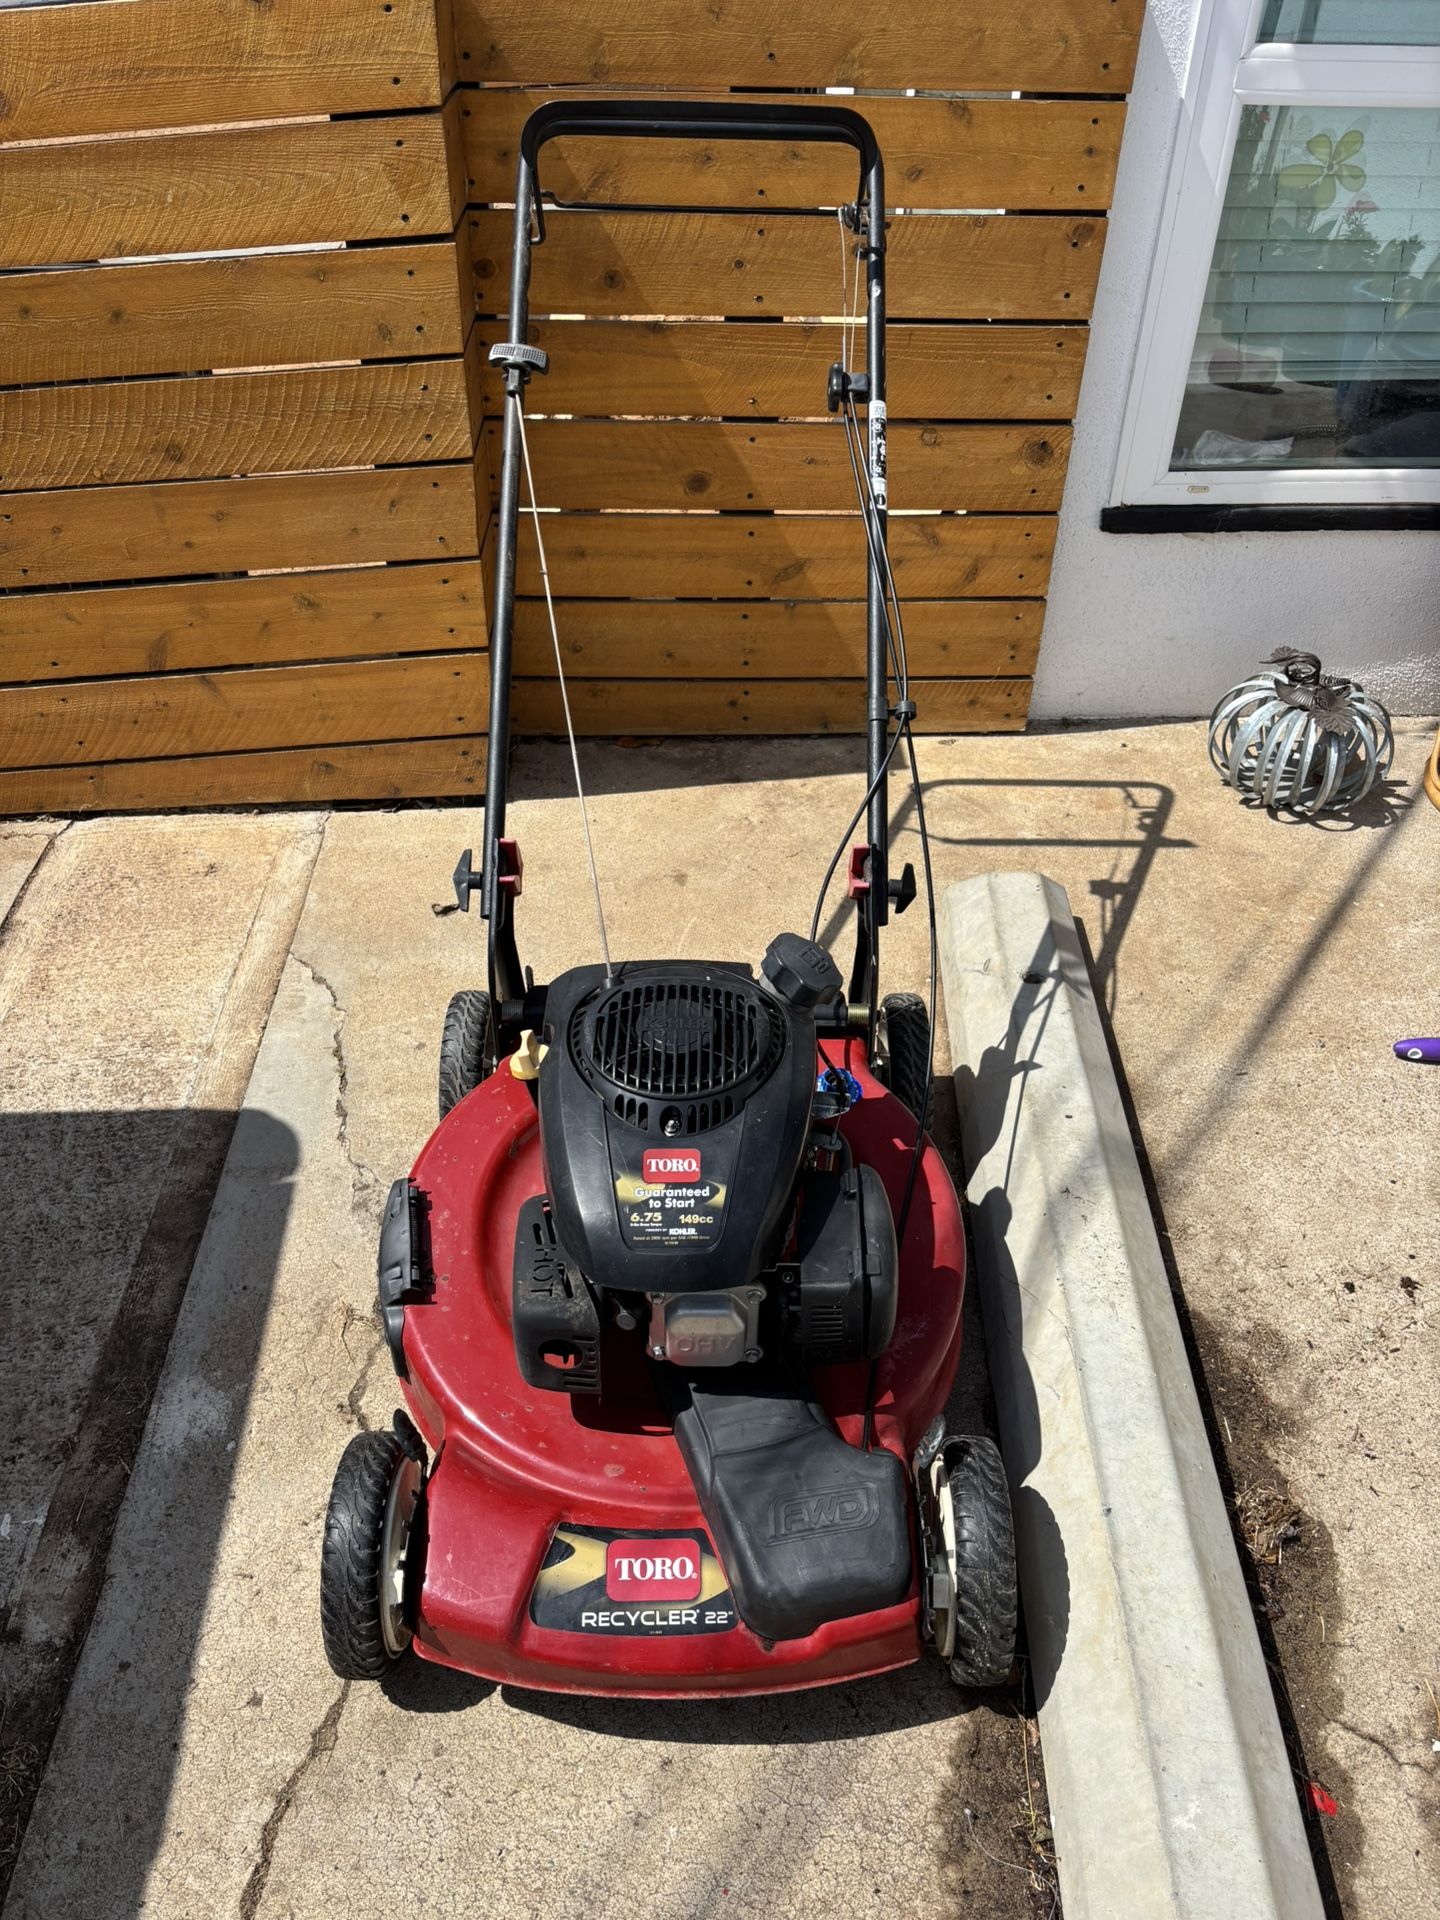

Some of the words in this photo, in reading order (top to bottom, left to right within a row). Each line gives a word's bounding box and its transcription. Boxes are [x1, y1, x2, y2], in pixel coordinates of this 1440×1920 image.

[647, 1158, 697, 1172] TORO
[635, 1186, 710, 1197] Guaranteed
[649, 1199, 661, 1208] to
[665, 1198, 695, 1208] Start
[630, 1212, 662, 1222] 6.75
[679, 1214, 714, 1224] 149cc
[530, 1248, 557, 1297] HOT
[675, 1336, 736, 1353] OHV
[784, 1493, 864, 1531] FWD
[615, 1556, 694, 1580] TORO
[581, 1610, 698, 1627] RECYCLER
[705, 1611, 733, 1624] 22"
